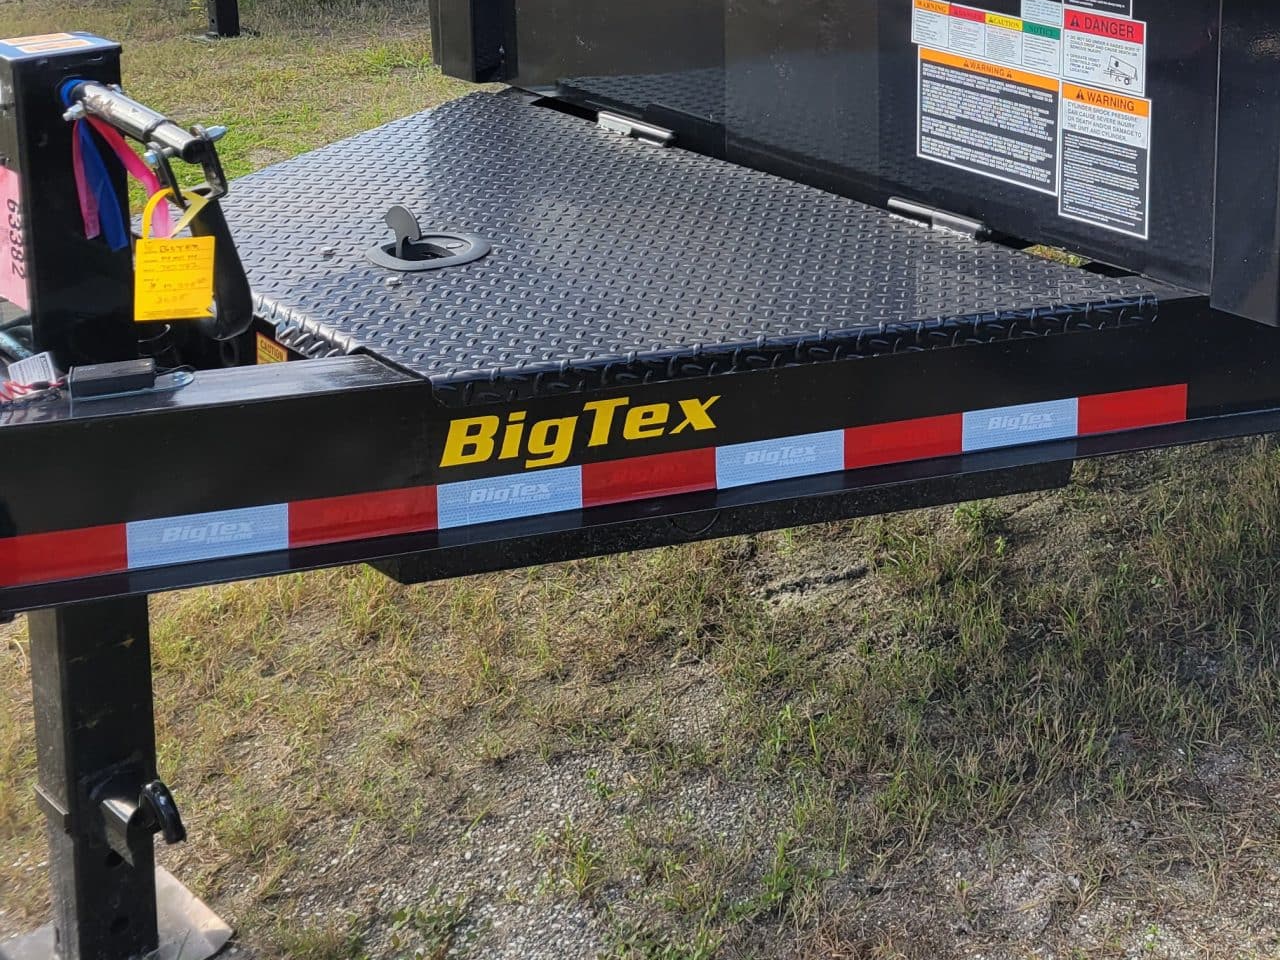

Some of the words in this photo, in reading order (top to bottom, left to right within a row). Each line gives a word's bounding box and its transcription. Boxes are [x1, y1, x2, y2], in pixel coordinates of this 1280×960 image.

[993, 17, 1020, 29] CAUTION
[1084, 16, 1135, 38] DANGER
[968, 61, 1004, 76] WARNING
[1087, 91, 1135, 111] WARNING
[1075, 117, 1092, 125] DEATH
[1113, 126, 1134, 135] DAMAGE
[1079, 111, 1096, 119] CAUSE
[1096, 116, 1116, 124] SEVERE
[1111, 112, 1137, 121] PRESSURE
[260, 339, 284, 362] CAUTION
[988, 412, 1054, 431] BigTex
[439, 395, 721, 469] BigTex
[743, 445, 817, 466] BigTex
[468, 483, 552, 504] BigTex
[161, 521, 256, 543] BigTex
